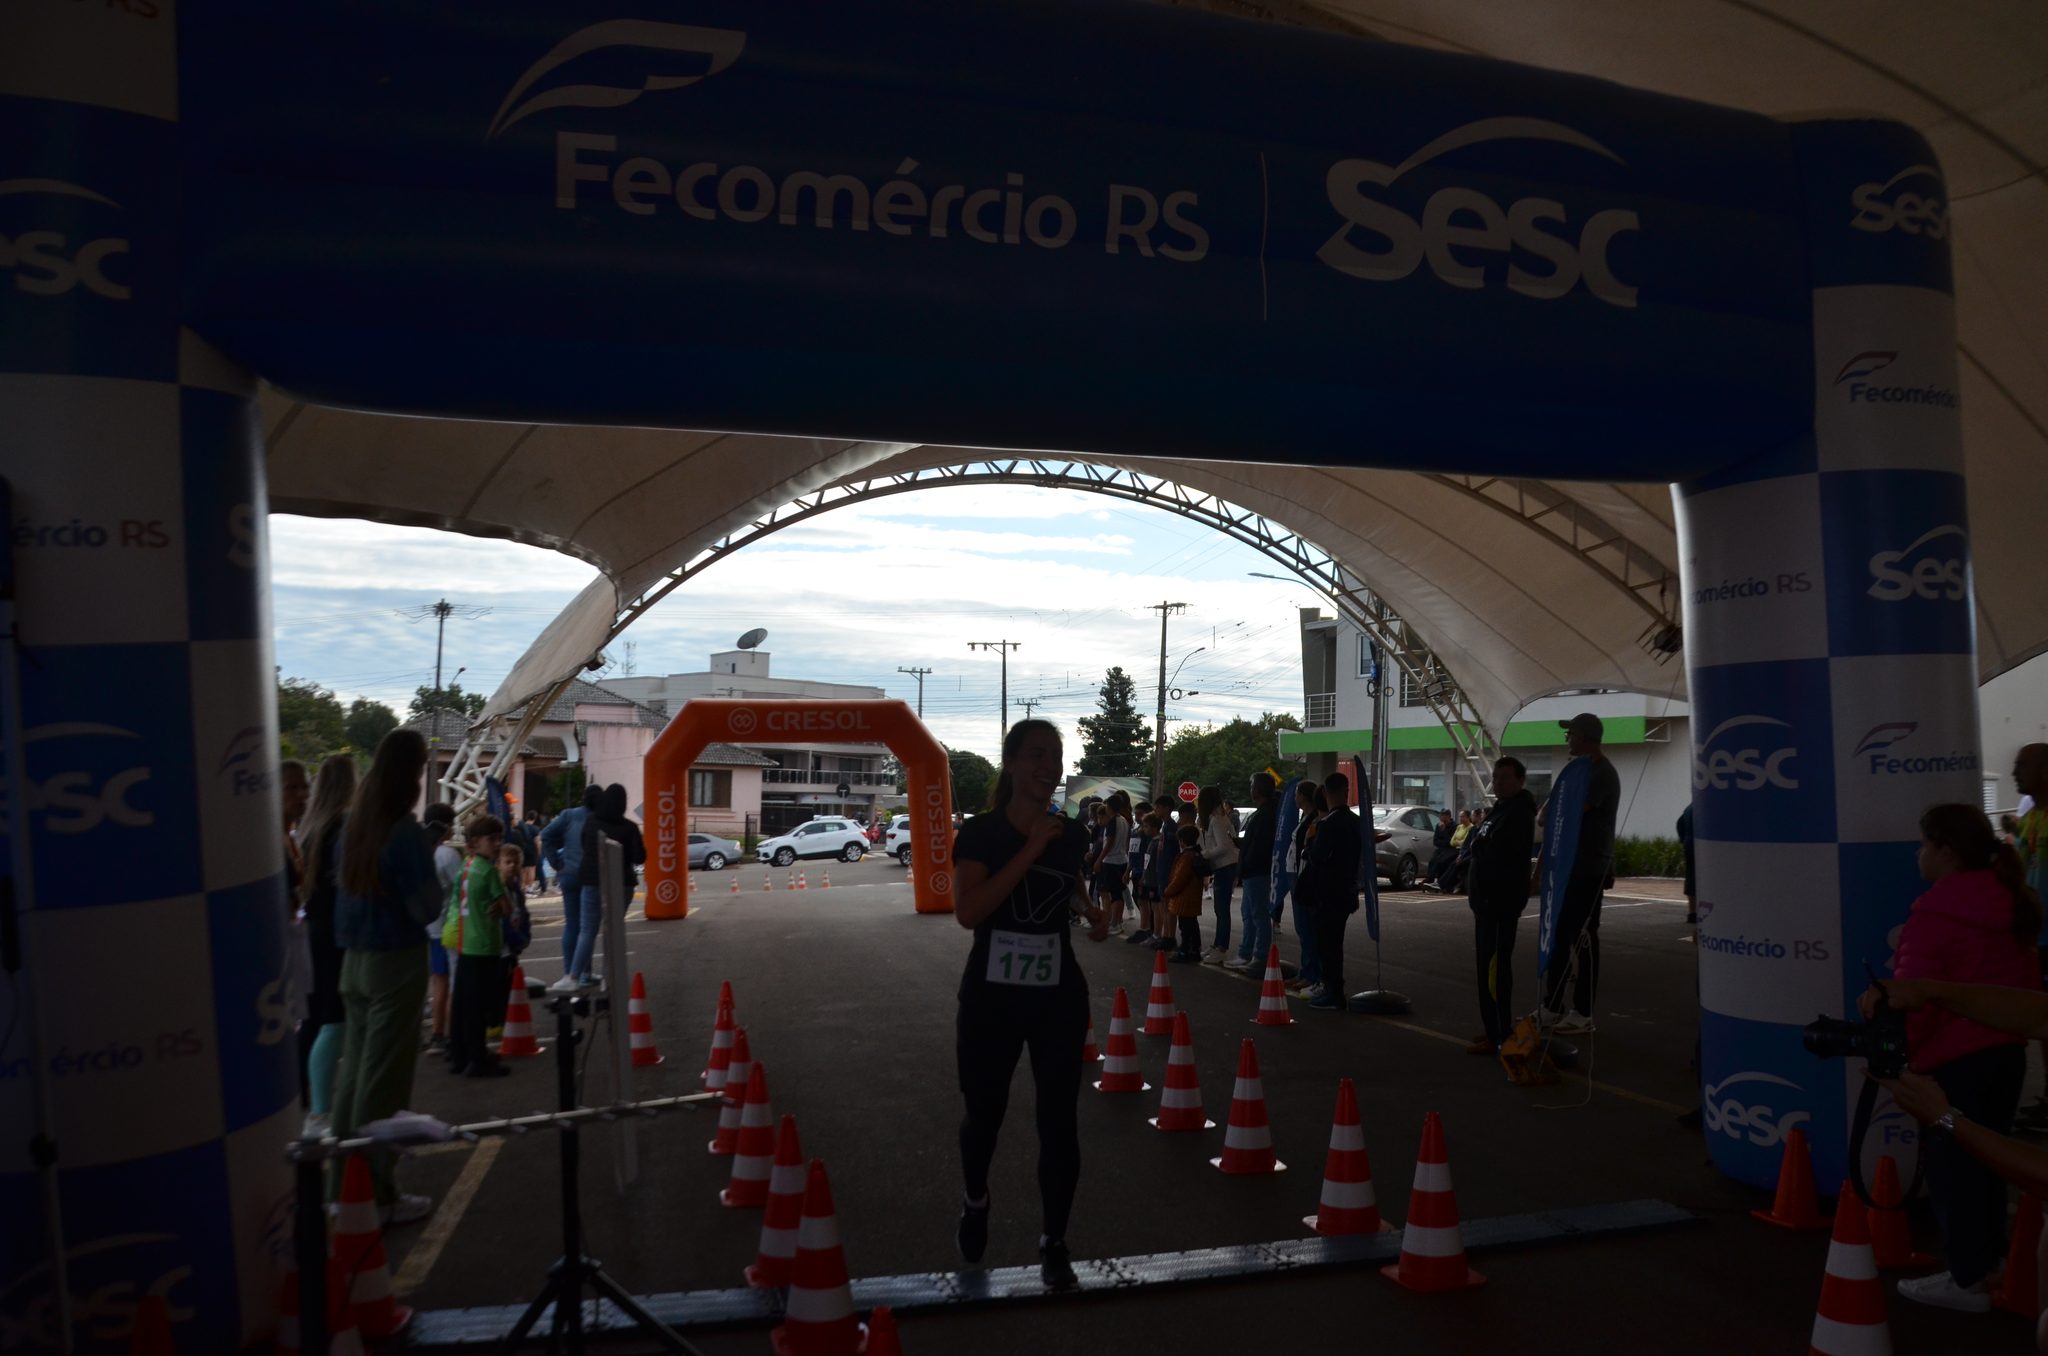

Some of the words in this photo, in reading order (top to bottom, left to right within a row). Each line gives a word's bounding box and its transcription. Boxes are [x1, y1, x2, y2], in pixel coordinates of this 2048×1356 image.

[555, 131, 1078, 249] Fecomércio
[1105, 184, 1210, 262] RS
[1316, 150, 1641, 309] Sesc
[121, 520, 170, 548] RS
[1777, 571, 1812, 594] RS
[766, 710, 871, 731] CRESOL
[1180, 788, 1197, 796] PARE
[658, 783, 676, 873] CRESOL
[927, 777, 946, 865] CRESOL
[1000, 951, 1053, 982] 175
[1794, 941, 1830, 961] RS
[156, 1029, 203, 1062] RS
